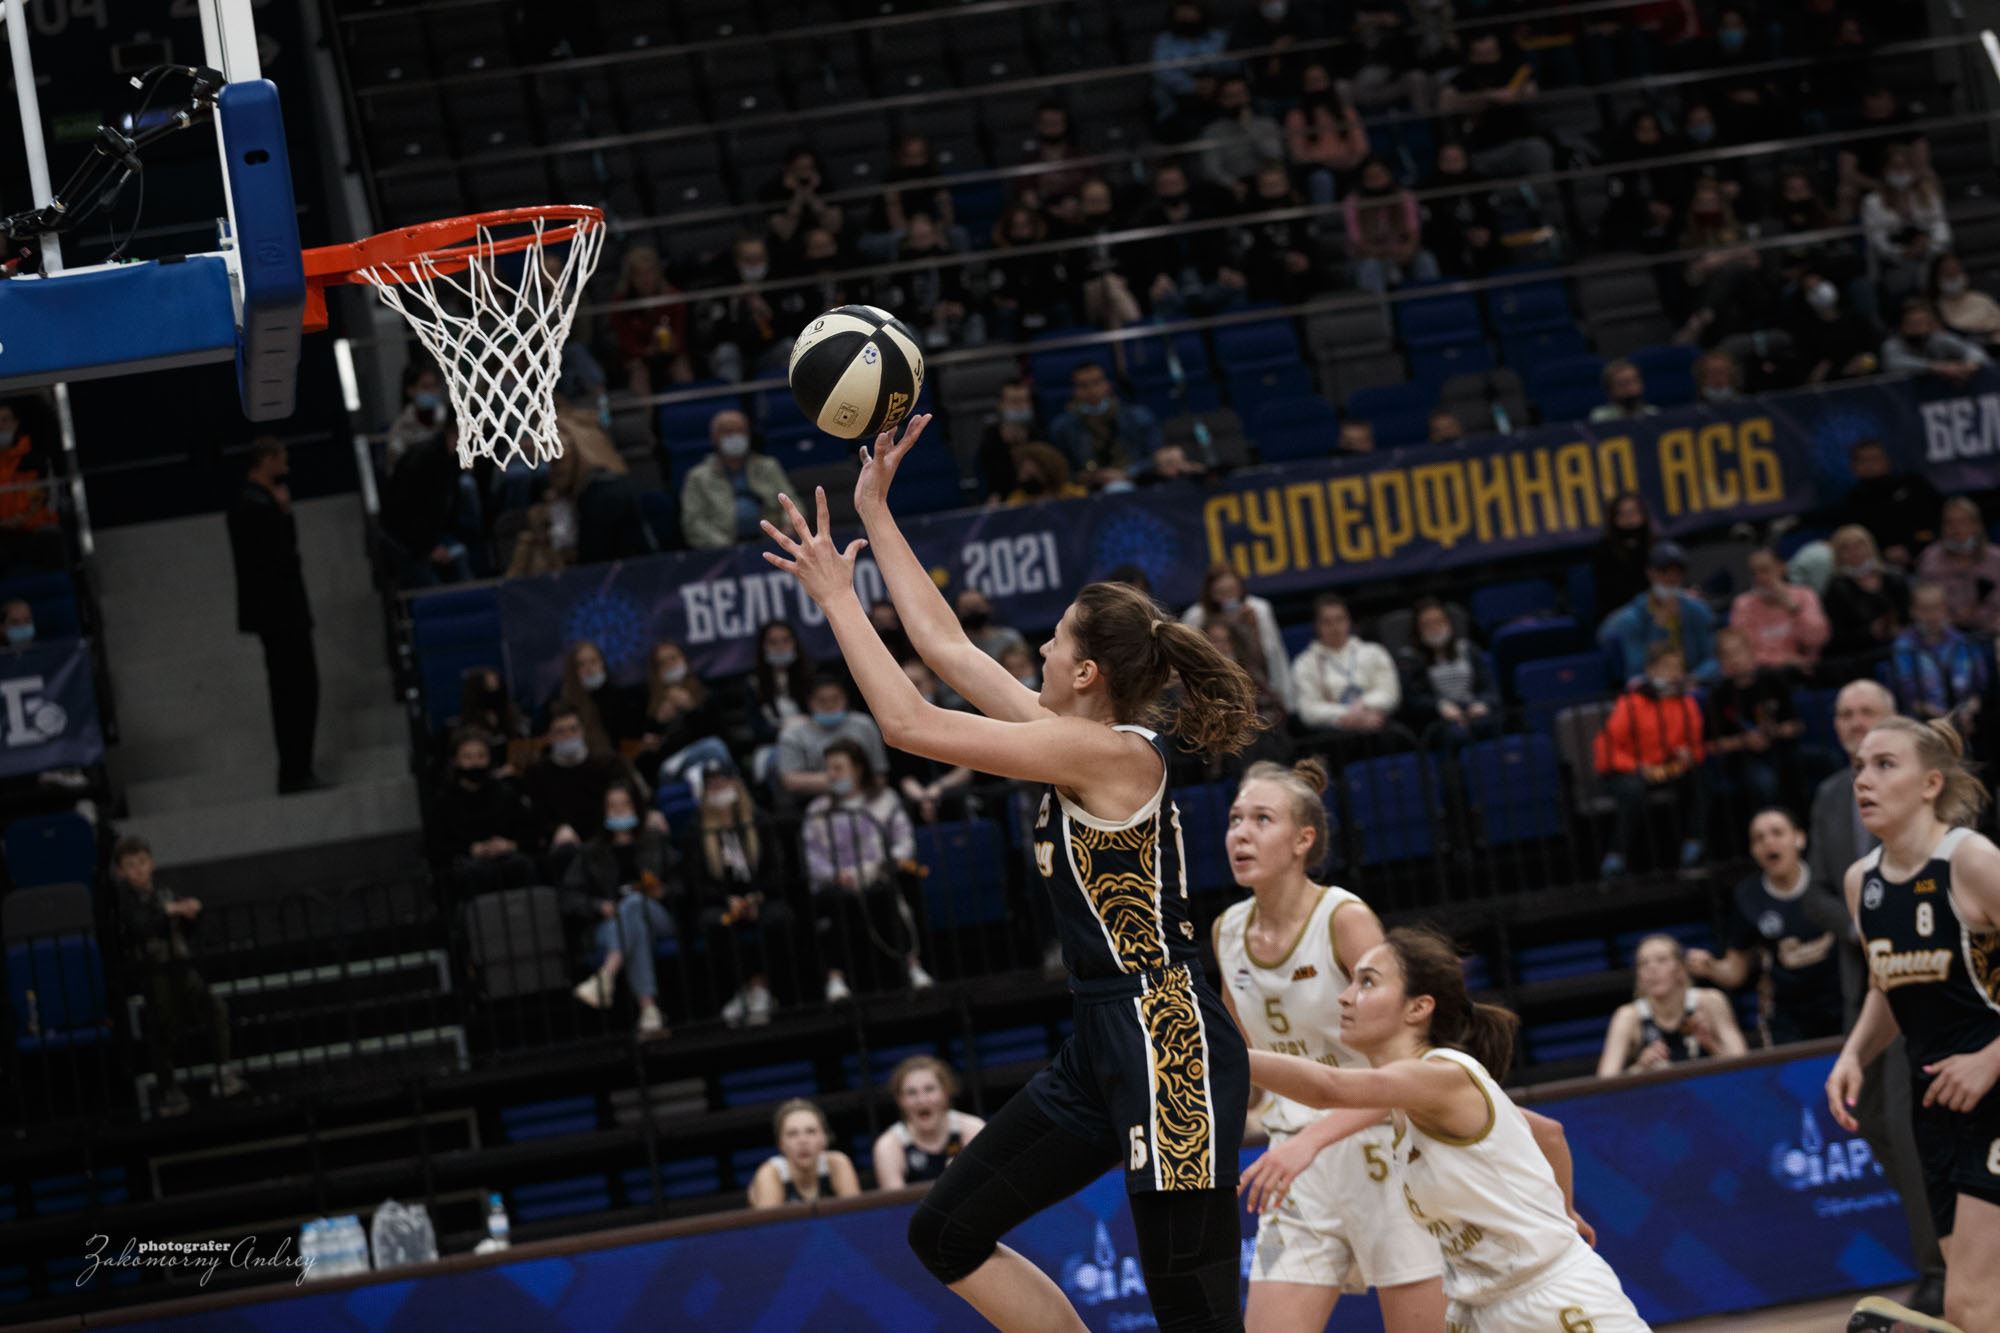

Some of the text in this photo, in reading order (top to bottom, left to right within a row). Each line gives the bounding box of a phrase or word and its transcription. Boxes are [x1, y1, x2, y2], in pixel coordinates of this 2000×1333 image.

[1203, 417, 1784, 579] СУПЕРФИНАЛ АСБ
[961, 531, 1063, 599] 2021
[1915, 901, 1936, 937] 8
[1264, 997, 1291, 1034] 5
[1129, 1124, 1148, 1171] 15
[1363, 1144, 1389, 1183] 5
